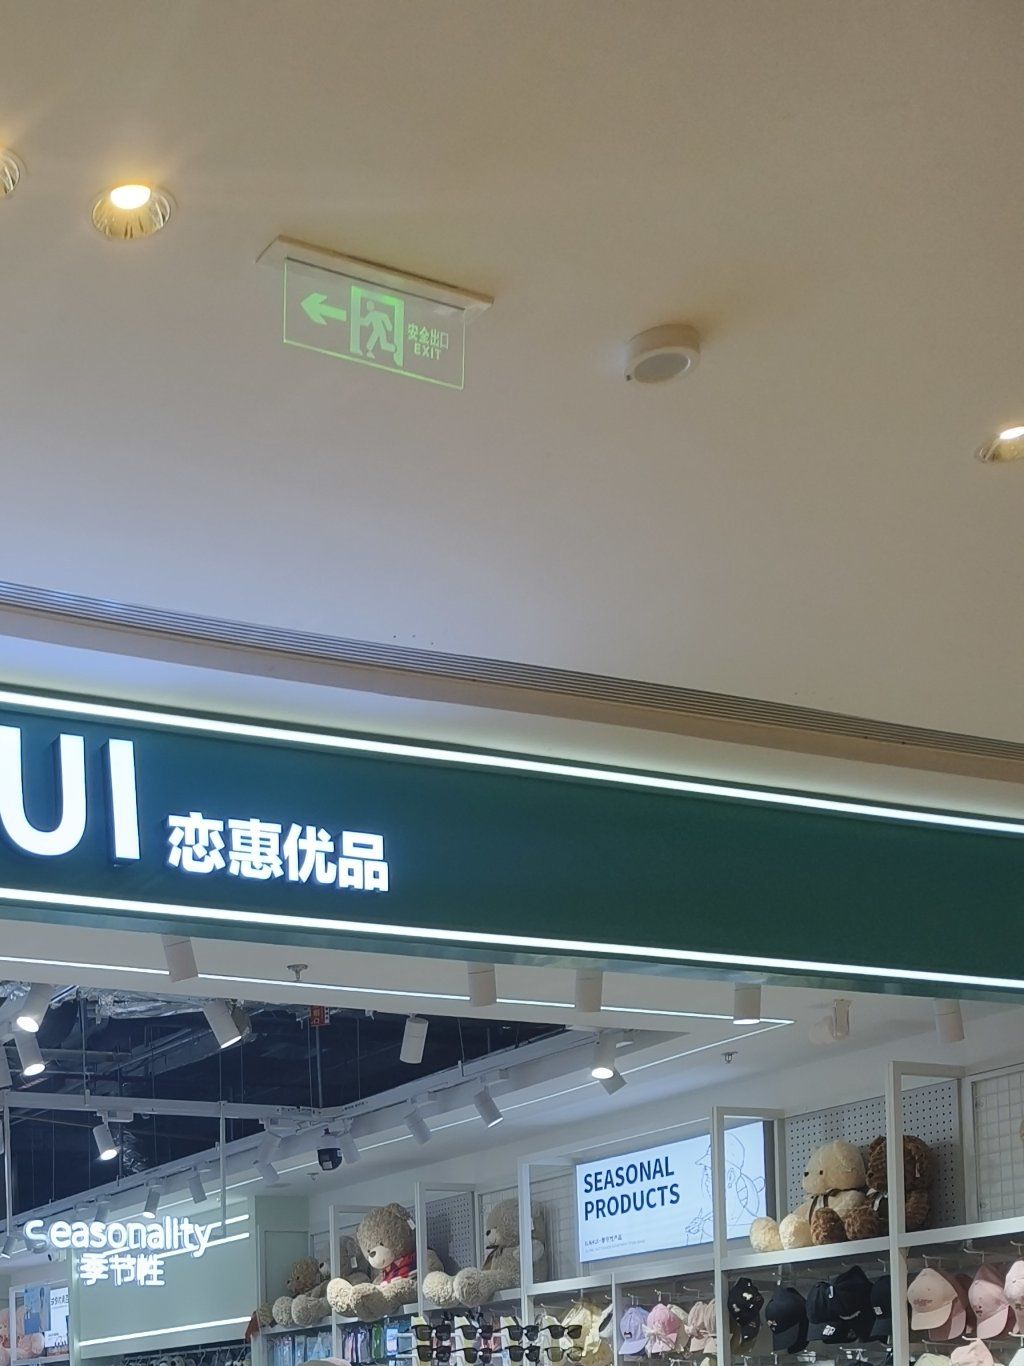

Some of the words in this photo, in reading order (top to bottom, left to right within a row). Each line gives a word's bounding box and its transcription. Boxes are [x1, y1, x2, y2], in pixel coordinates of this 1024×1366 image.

[407, 322, 449, 350] 安全出口
[414, 342, 442, 361] EXIT
[167, 811, 391, 893] 恋惠优品
[583, 1156, 674, 1193] SEASONAL
[584, 1183, 680, 1221] PRODUCTS
[80, 1252, 165, 1286] 季节性
